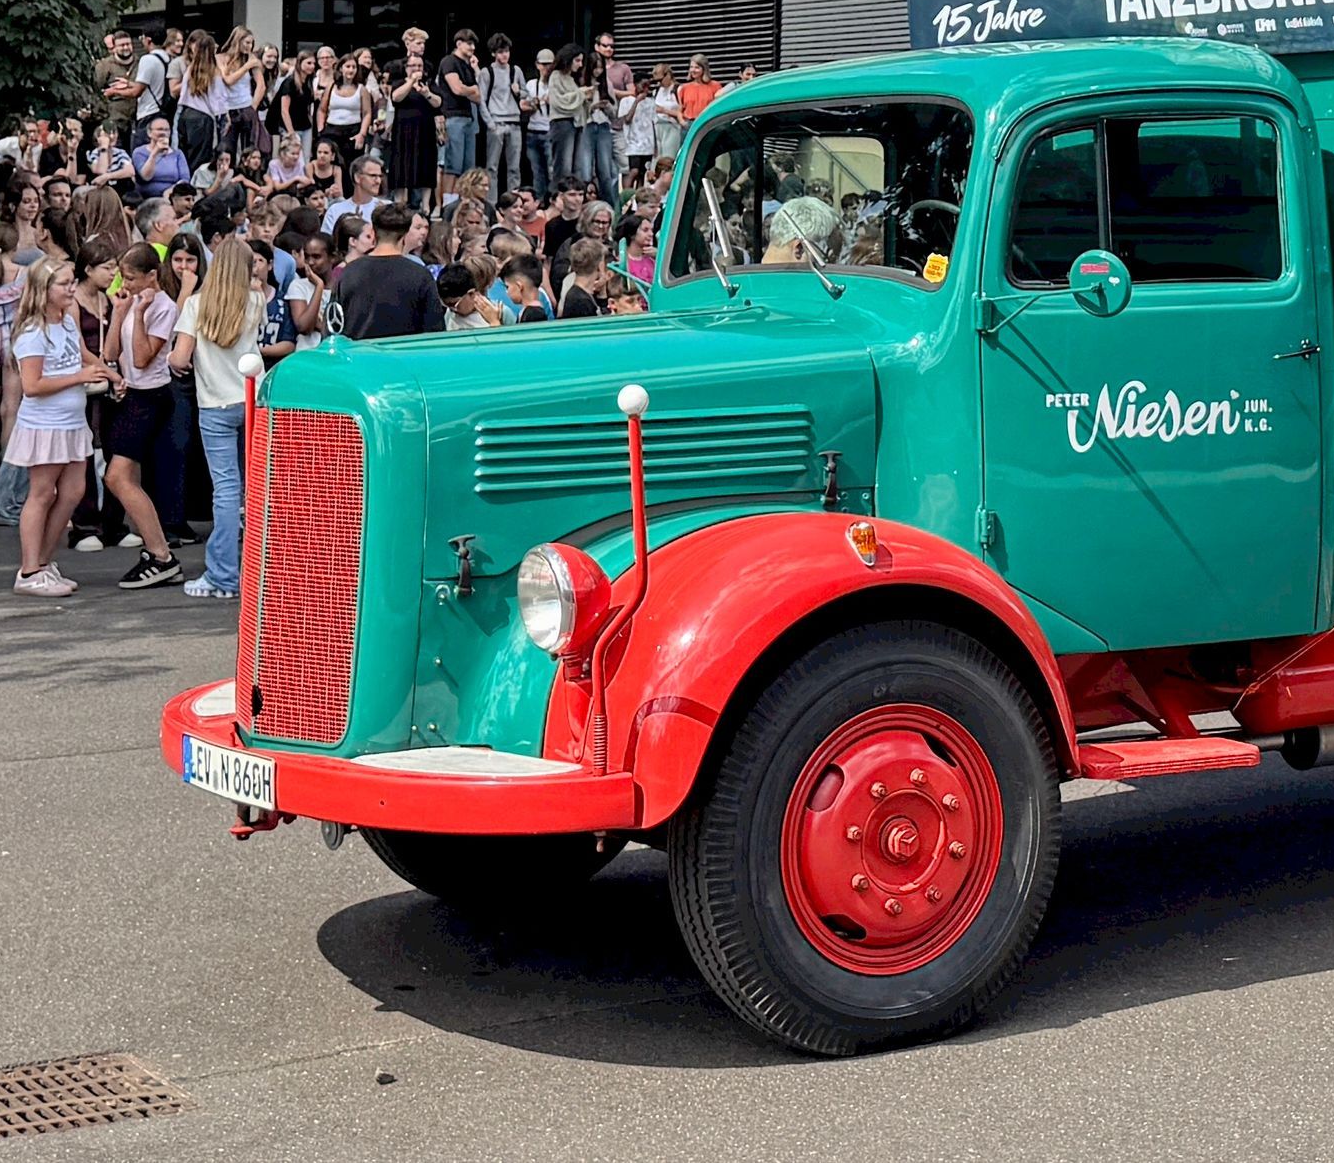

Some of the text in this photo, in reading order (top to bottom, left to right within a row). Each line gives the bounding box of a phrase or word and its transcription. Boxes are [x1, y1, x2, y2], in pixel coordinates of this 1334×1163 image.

[933, 3, 973, 45] 15
[1045, 380, 1273, 453] PETER Niesen JUN.
[1244, 418, 1273, 432] K.G.
[220, 754, 230, 793] N
